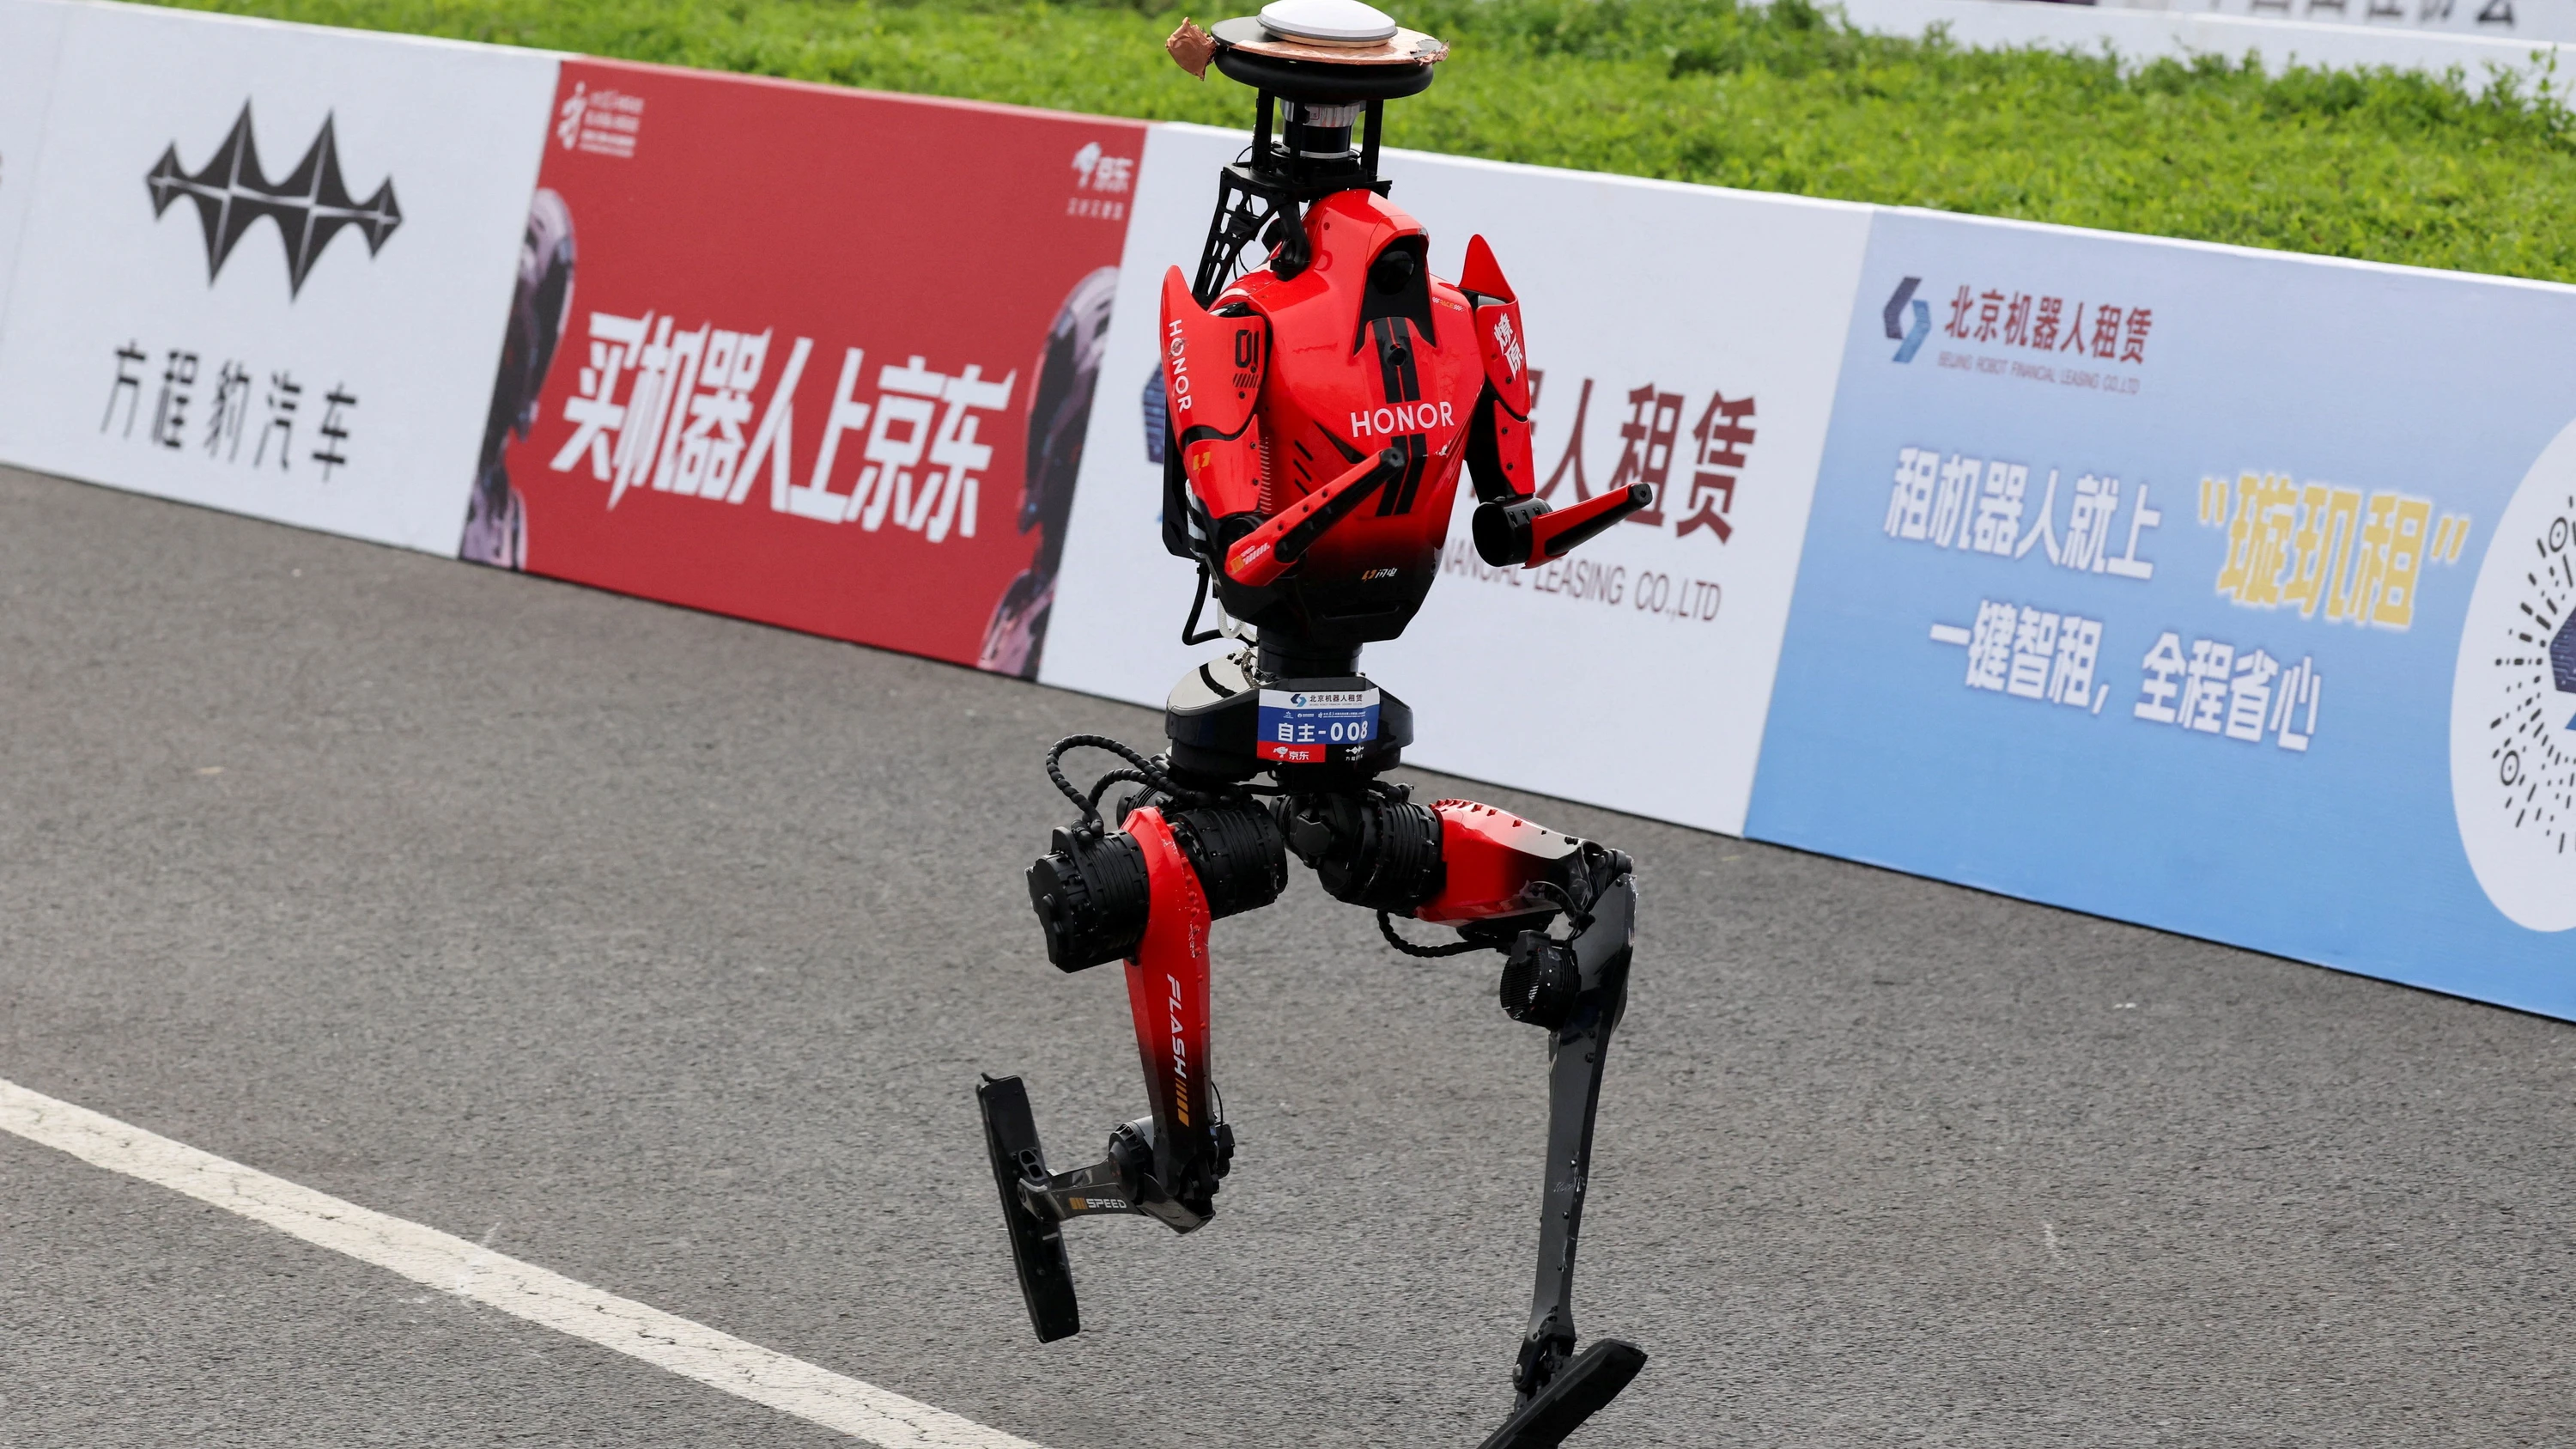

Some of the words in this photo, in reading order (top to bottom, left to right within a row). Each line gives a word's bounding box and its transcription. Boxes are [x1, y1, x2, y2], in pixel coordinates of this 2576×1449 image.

[1944, 285, 2152, 364] 北京机器人租赁
[1169, 319, 1193, 413] HONOR
[100, 338, 358, 481] 方程豹汽车
[550, 307, 1017, 544] 买机器人上京东
[1350, 401, 1454, 438] HONOR
[1883, 447, 2162, 580] 租机器人就上
[1534, 557, 1625, 605] LEASING
[1309, 693, 1364, 703] 北京机器人租赁
[1278, 720, 1369, 743] 自主-008
[1288, 751, 1309, 761] 京东
[1166, 972, 1188, 1080] FLASH
[1085, 1198, 1127, 1209] SPEED
